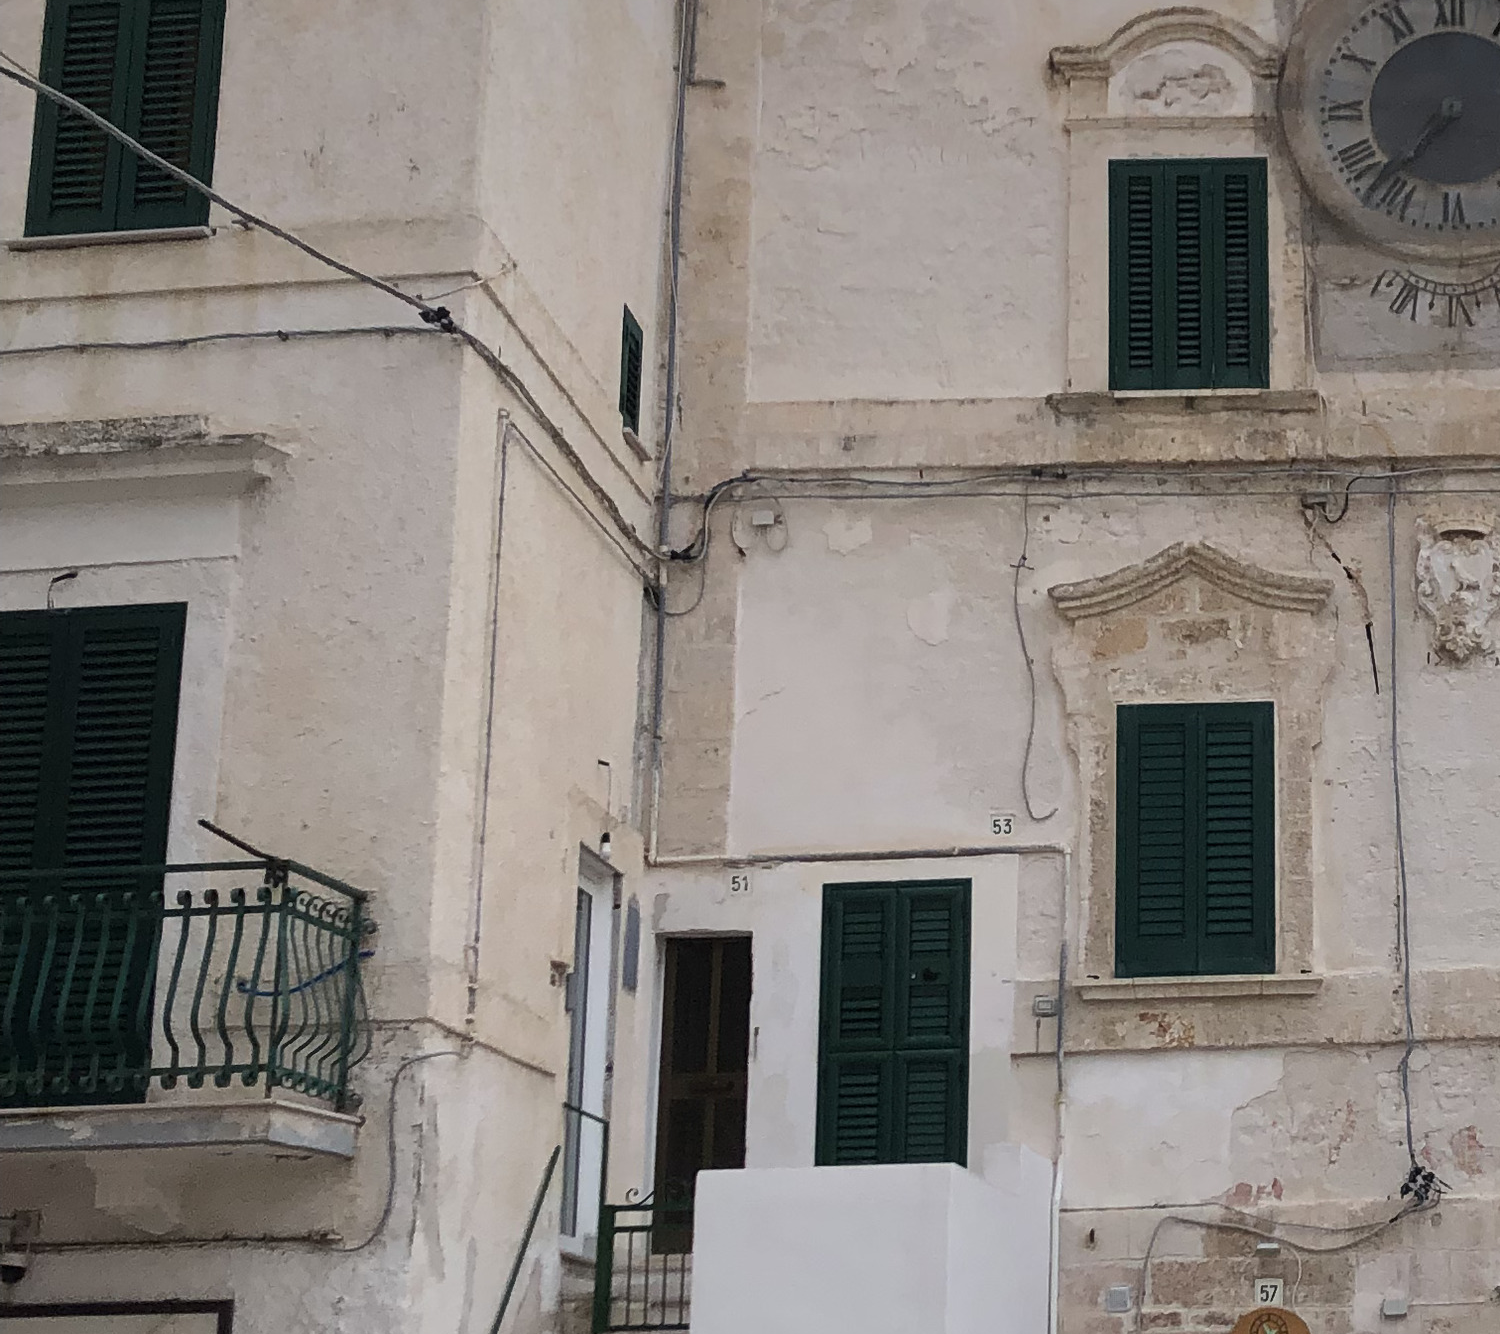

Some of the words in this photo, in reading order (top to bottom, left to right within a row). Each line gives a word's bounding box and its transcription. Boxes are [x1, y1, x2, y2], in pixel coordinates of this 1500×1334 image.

[1379, 5, 1415, 45] XI
[993, 818, 1012, 835] 53
[731, 875, 749, 892] 51
[1259, 1284, 1279, 1303] 57
